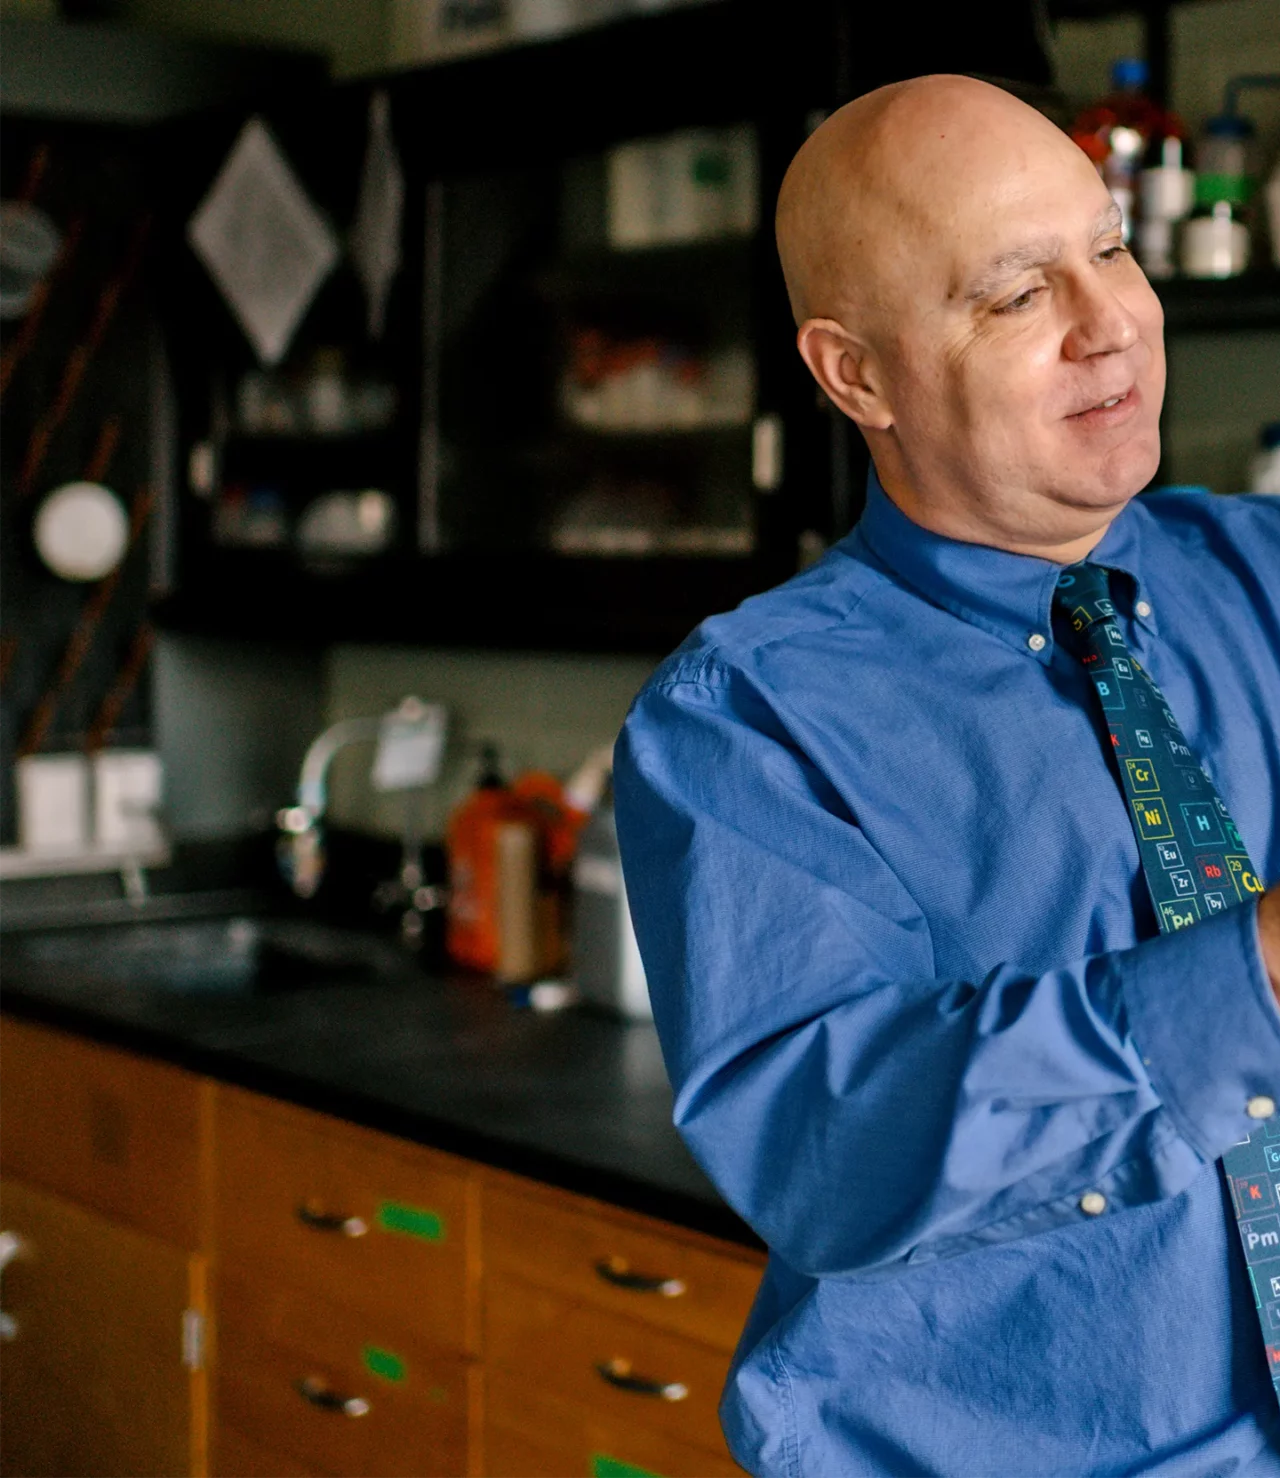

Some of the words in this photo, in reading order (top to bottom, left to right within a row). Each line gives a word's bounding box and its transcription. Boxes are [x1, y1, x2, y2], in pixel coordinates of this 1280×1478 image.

[1096, 682, 1110, 696] B
[1110, 734, 1120, 746] K
[1169, 741, 1191, 756] Pm
[1136, 769, 1149, 782] Cr
[1144, 809, 1162, 826] Ni
[1196, 815, 1210, 831] H
[1163, 850, 1177, 860] Eu
[1204, 865, 1222, 878] Rb
[1230, 861, 1242, 871] 29
[1177, 878, 1188, 888] Zr
[1242, 872, 1265, 893] Cu
[1164, 906, 1175, 915] 46
[1210, 900, 1222, 910] Dy
[1250, 1184, 1262, 1199] K
[1242, 1223, 1252, 1234] 61
[1247, 1231, 1279, 1249] Pm
